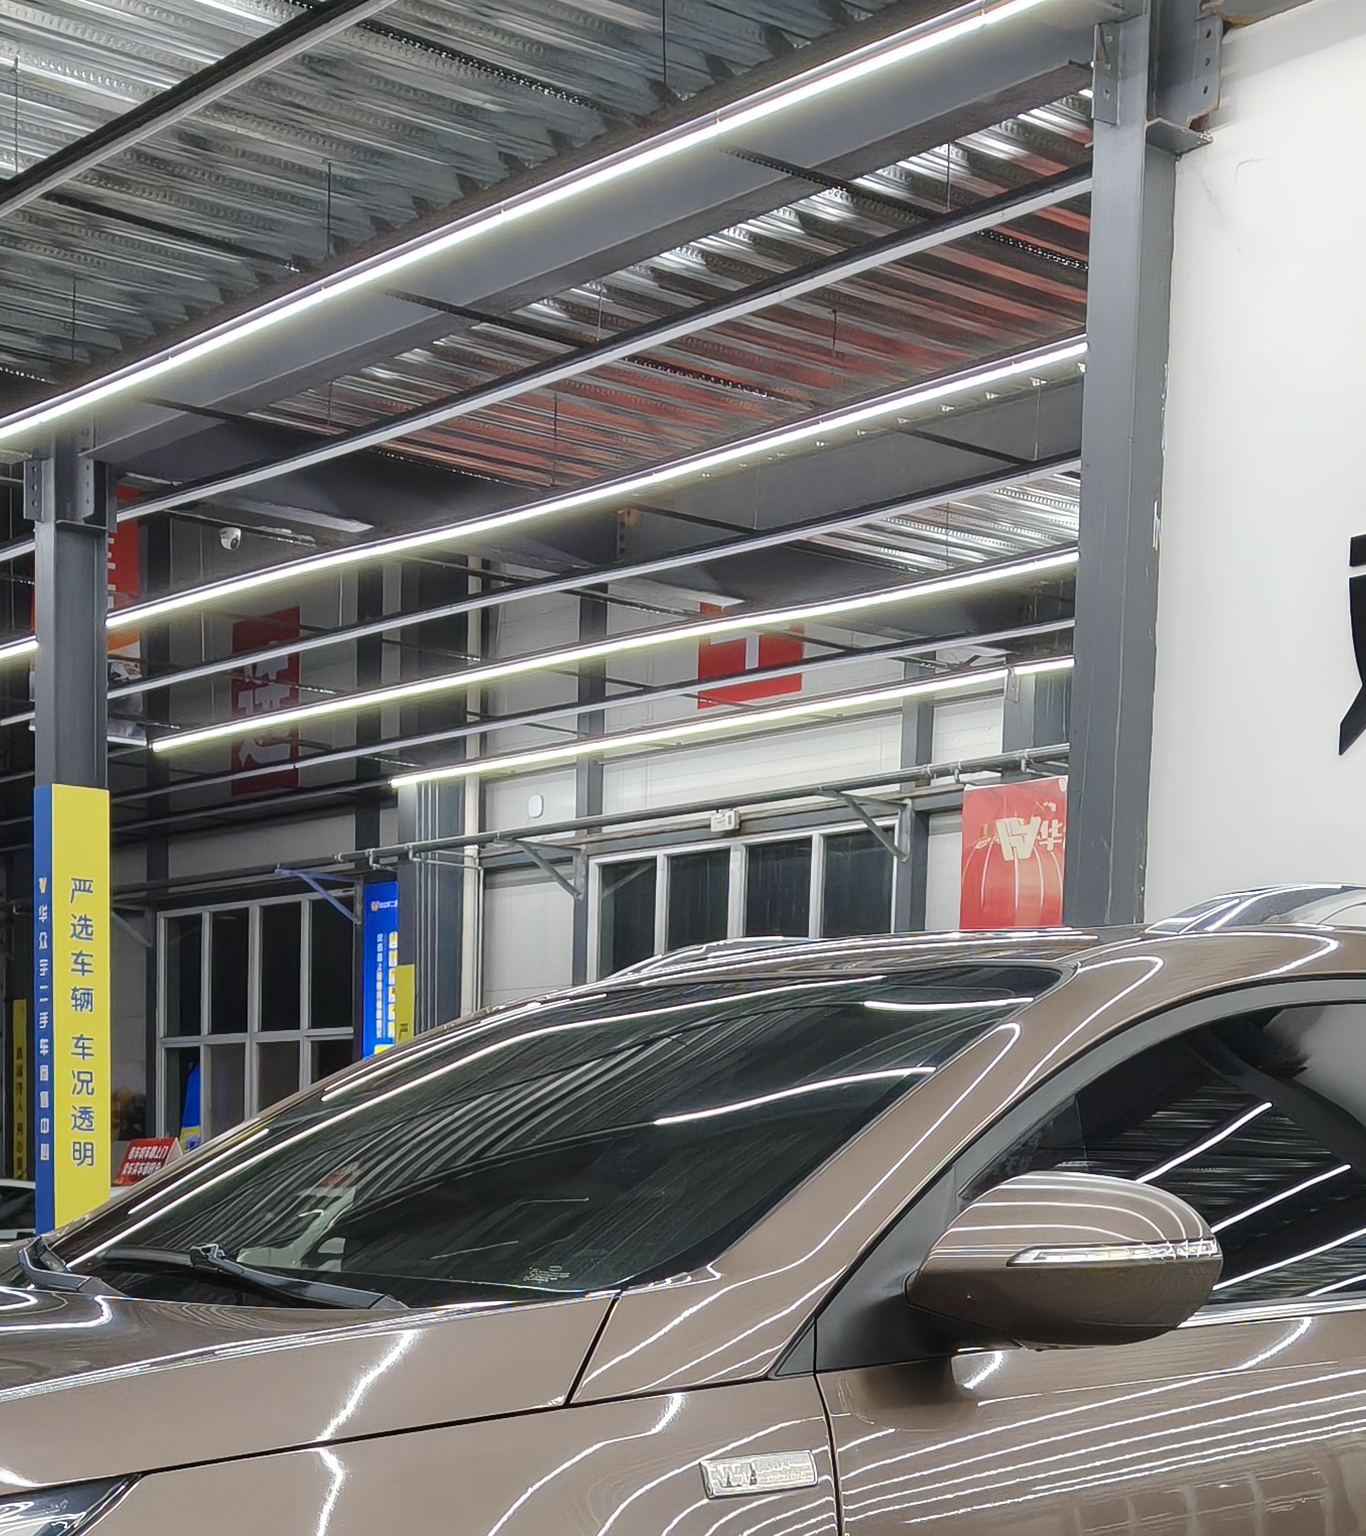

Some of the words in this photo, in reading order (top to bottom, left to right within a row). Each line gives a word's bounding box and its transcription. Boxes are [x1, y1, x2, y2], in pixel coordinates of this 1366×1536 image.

[69, 877, 94, 1013] 严选车辆
[70, 1033, 95, 1167] 车况透明
